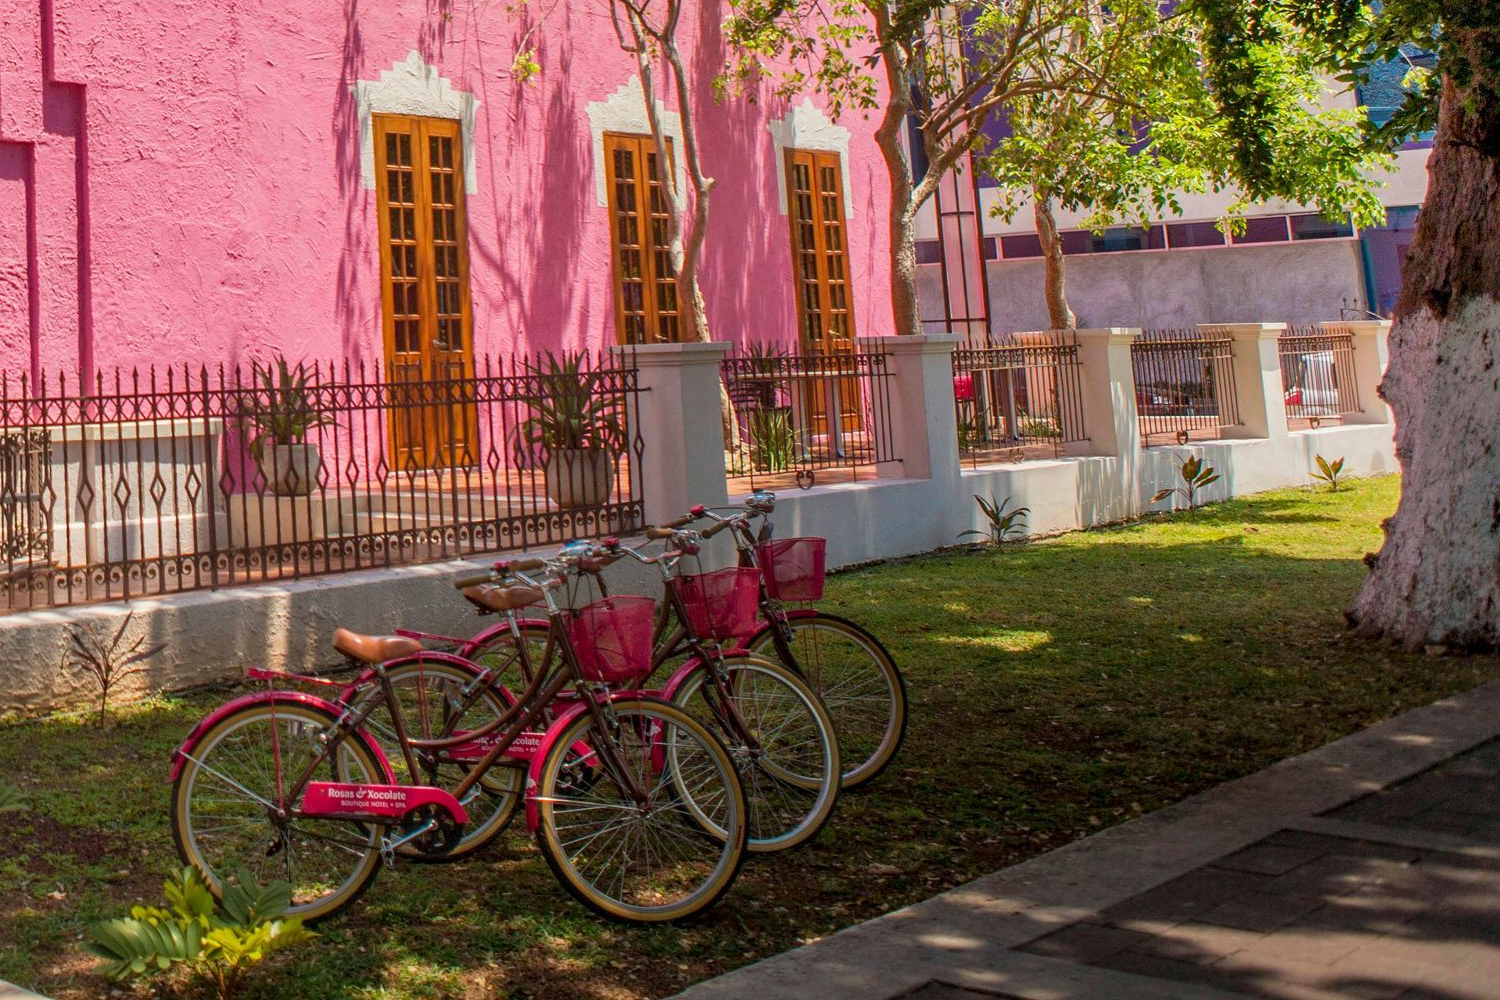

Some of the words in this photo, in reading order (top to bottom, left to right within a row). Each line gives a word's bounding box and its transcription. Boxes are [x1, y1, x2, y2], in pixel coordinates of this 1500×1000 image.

[328, 788, 355, 799] Rosas
[356, 787, 367, 799] &
[367, 790, 407, 800] Xocolate
[341, 800, 370, 808] BOUTIQUE
